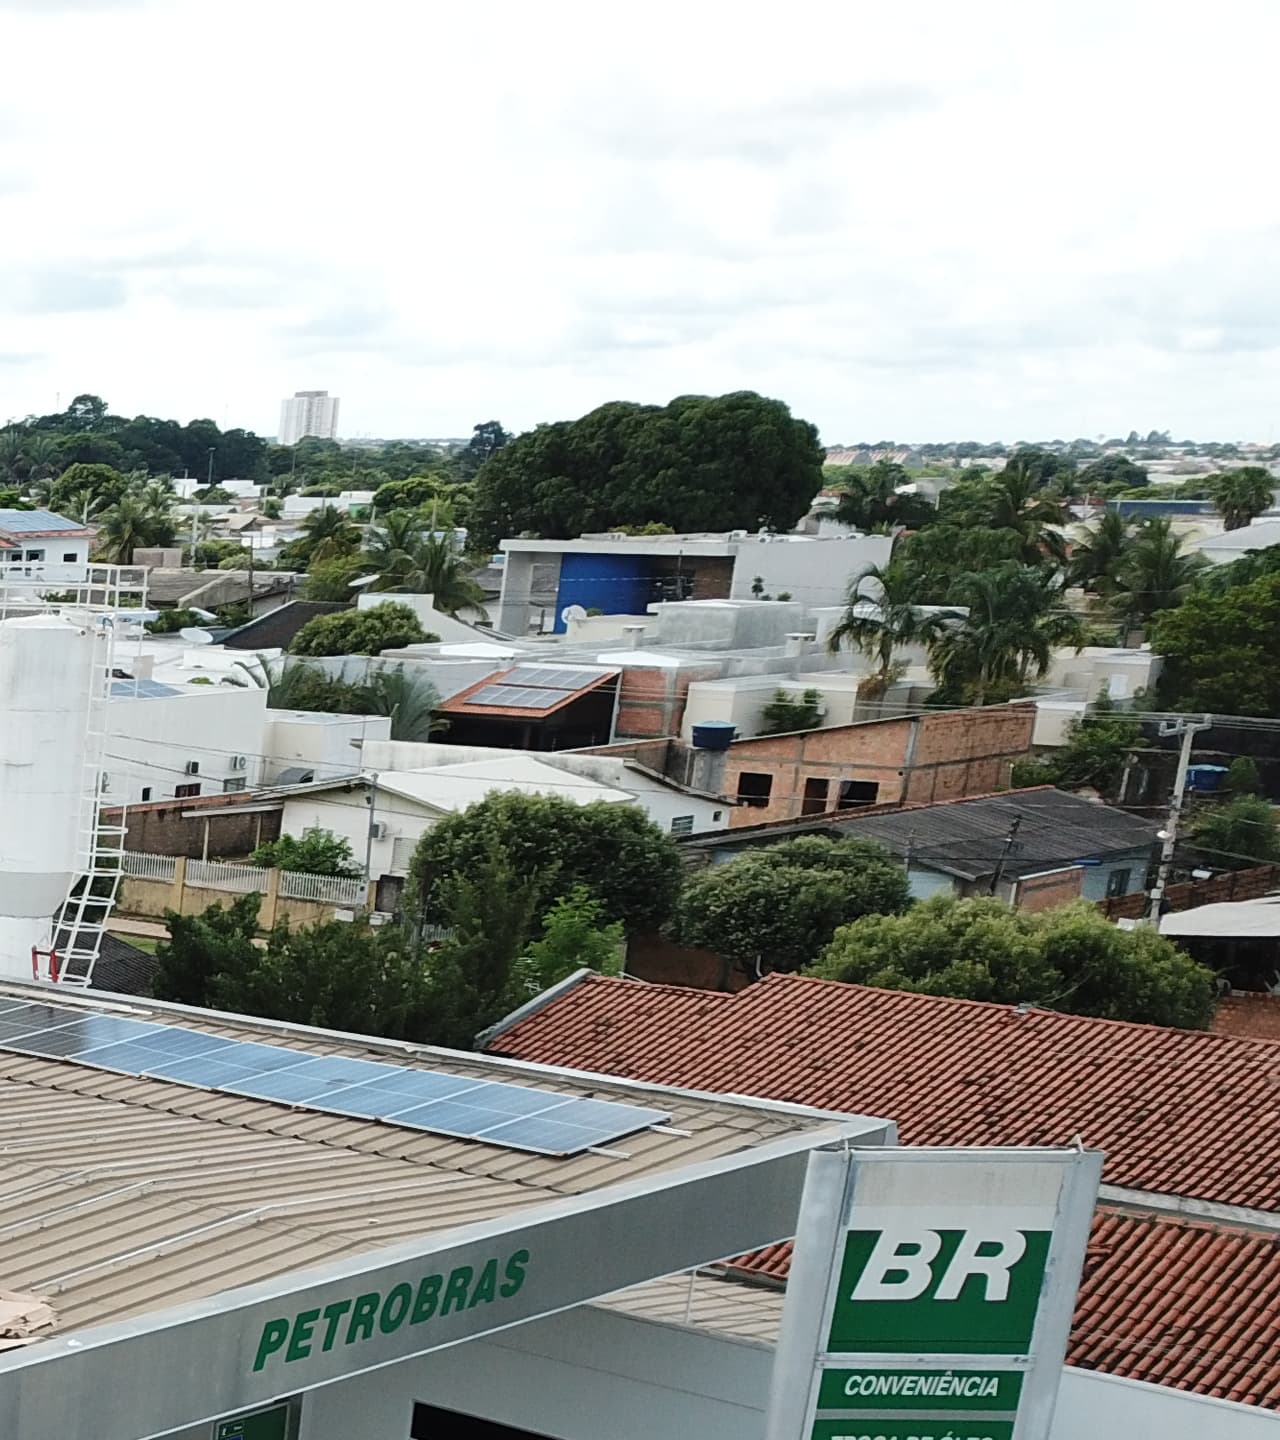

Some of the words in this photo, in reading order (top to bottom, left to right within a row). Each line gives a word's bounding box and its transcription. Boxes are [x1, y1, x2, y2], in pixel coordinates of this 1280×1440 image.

[850, 1229, 1027, 1301] BR
[252, 1249, 530, 1373] PETROBRAS
[844, 1371, 999, 1397] CONVENIÊNCIA
